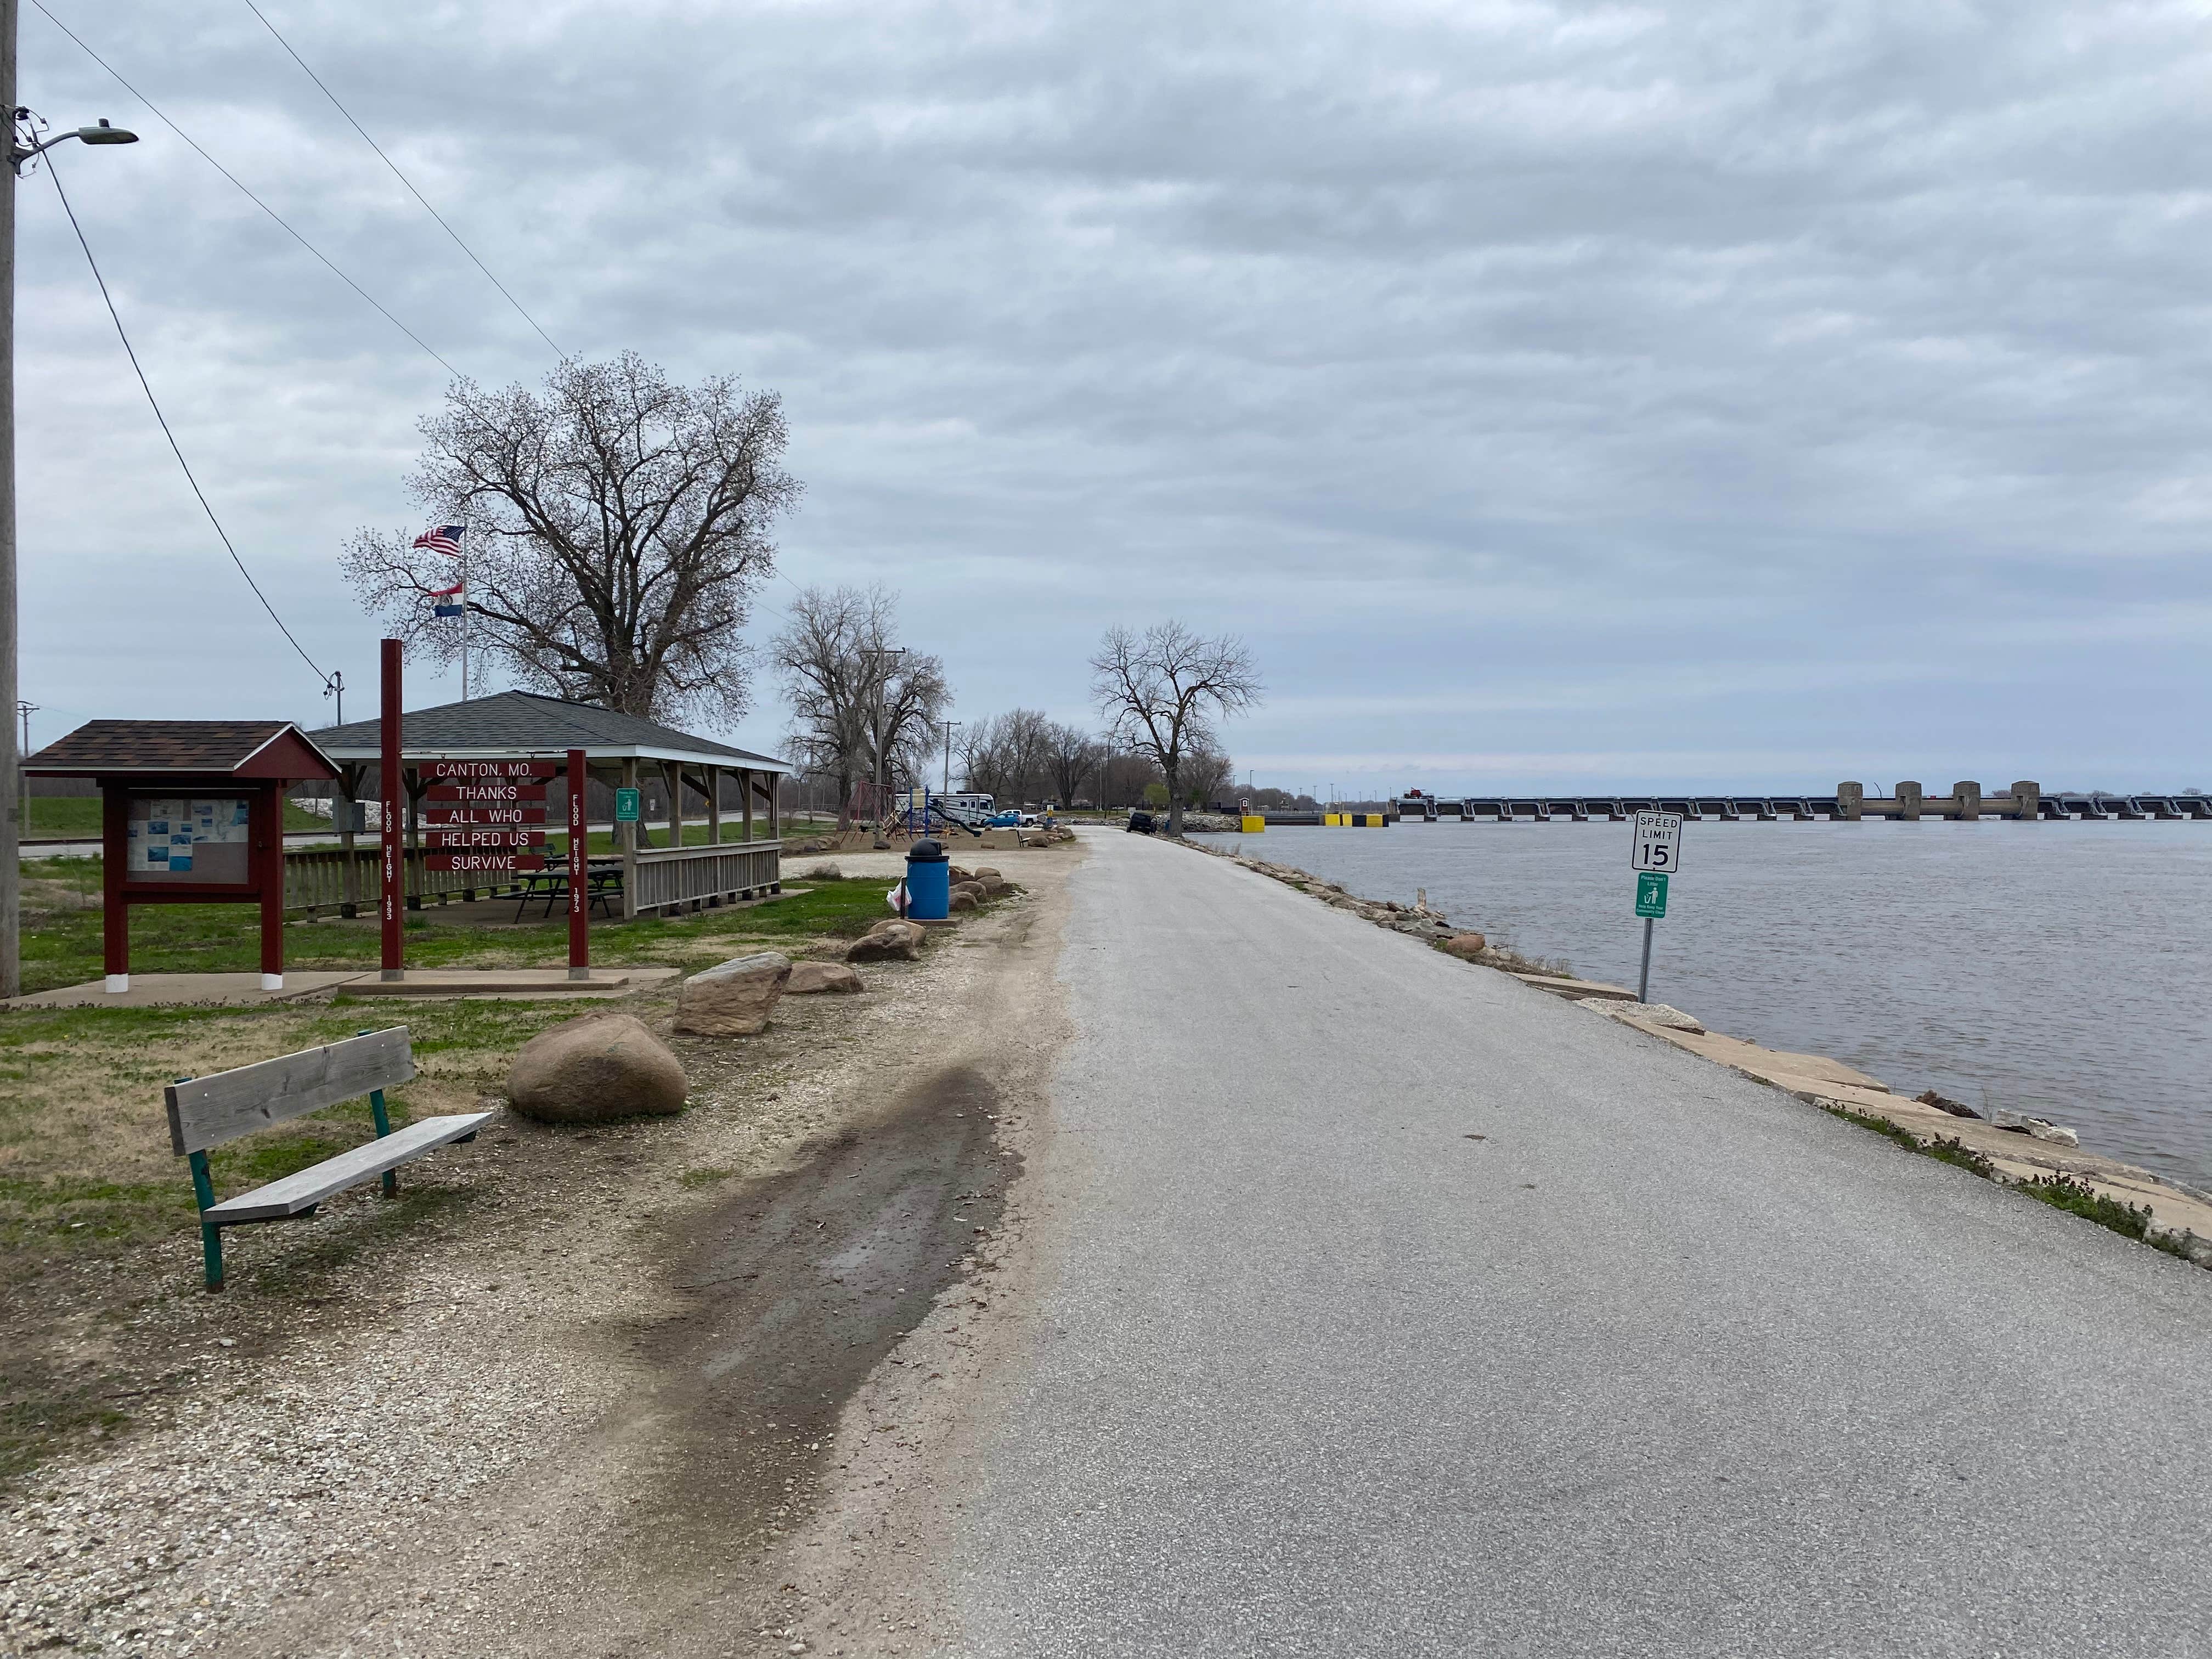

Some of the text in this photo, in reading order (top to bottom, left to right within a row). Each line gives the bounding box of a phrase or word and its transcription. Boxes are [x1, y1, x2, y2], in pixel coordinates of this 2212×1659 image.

[437, 763, 533, 776] CANTON, MO.
[456, 786, 517, 799] THANKS
[450, 809, 522, 823] ALL WHO
[1640, 817, 1678, 828] SPEED
[442, 833, 528, 846] HELPED US
[1642, 830, 1673, 840] LIMIT
[1643, 843, 1669, 866] 15
[452, 856, 516, 870] SURVIVE
